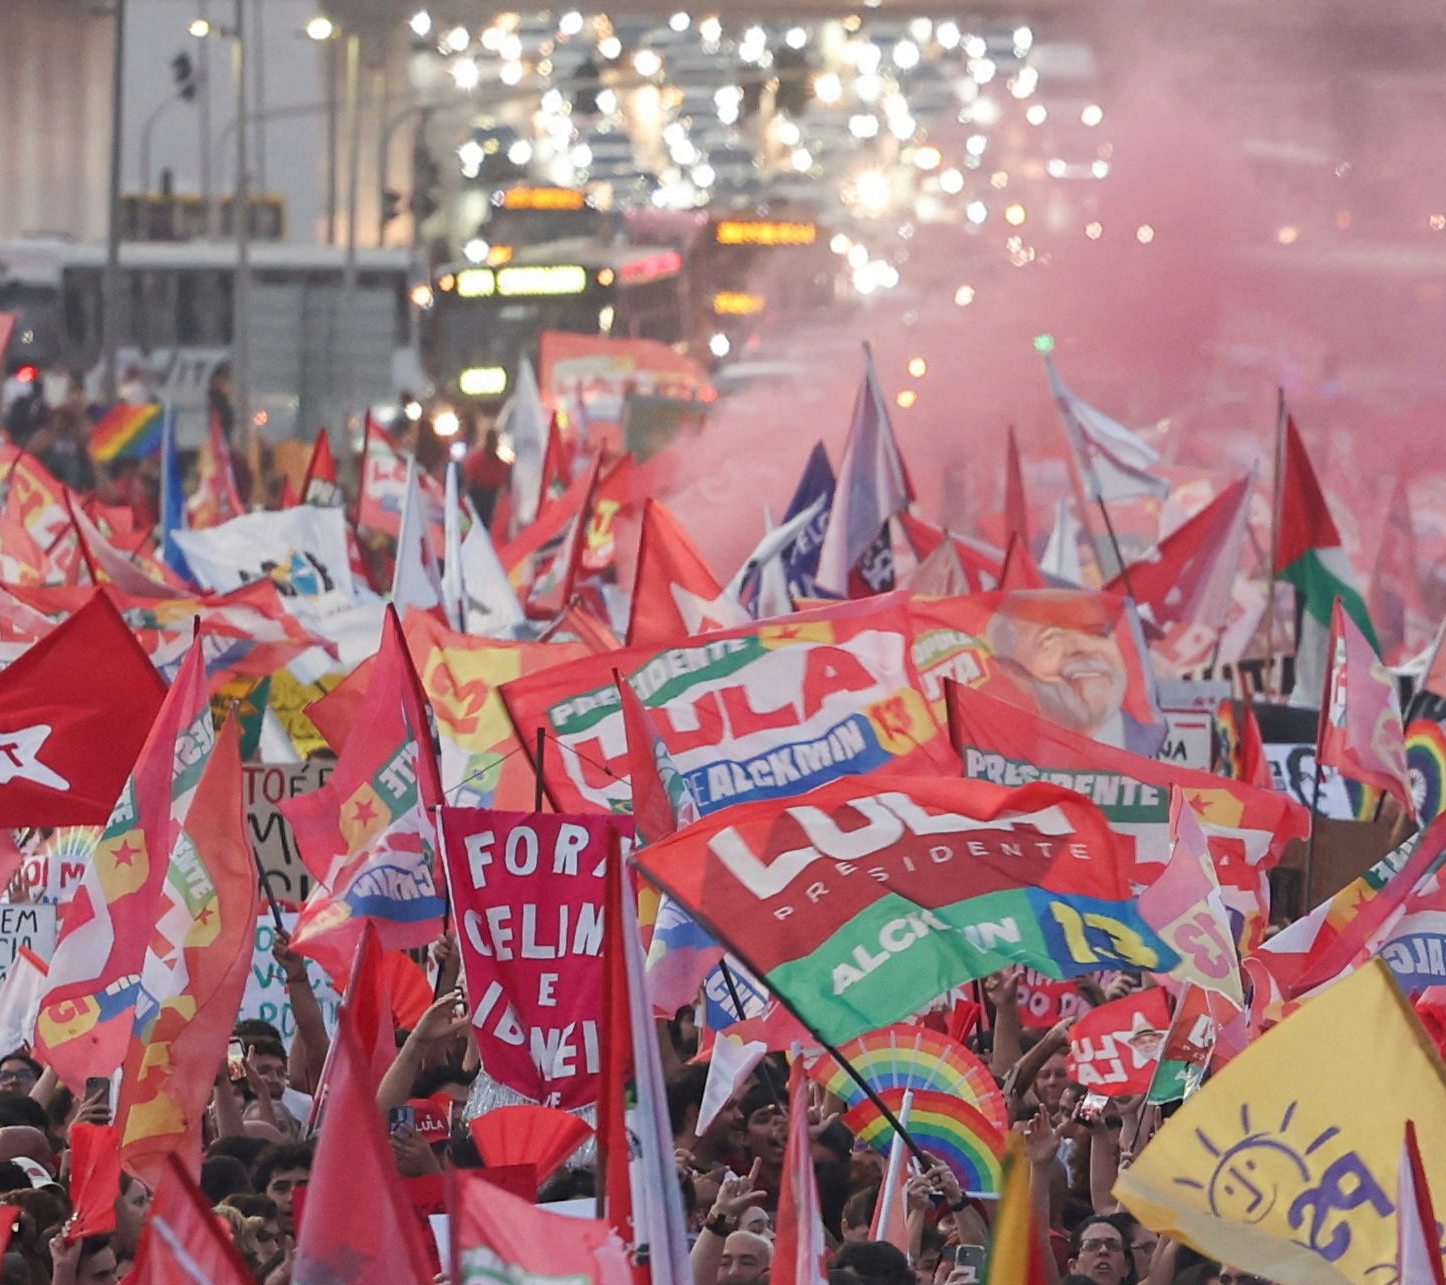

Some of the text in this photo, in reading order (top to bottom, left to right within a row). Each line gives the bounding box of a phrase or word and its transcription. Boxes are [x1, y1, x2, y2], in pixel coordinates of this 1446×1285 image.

[708, 719, 866, 801] ALCKMIN
[772, 842, 1093, 921] PRESIDENTE
[2, 908, 39, 935] EM
[464, 902, 605, 962] CELIN
[1050, 898, 1160, 968] 13
